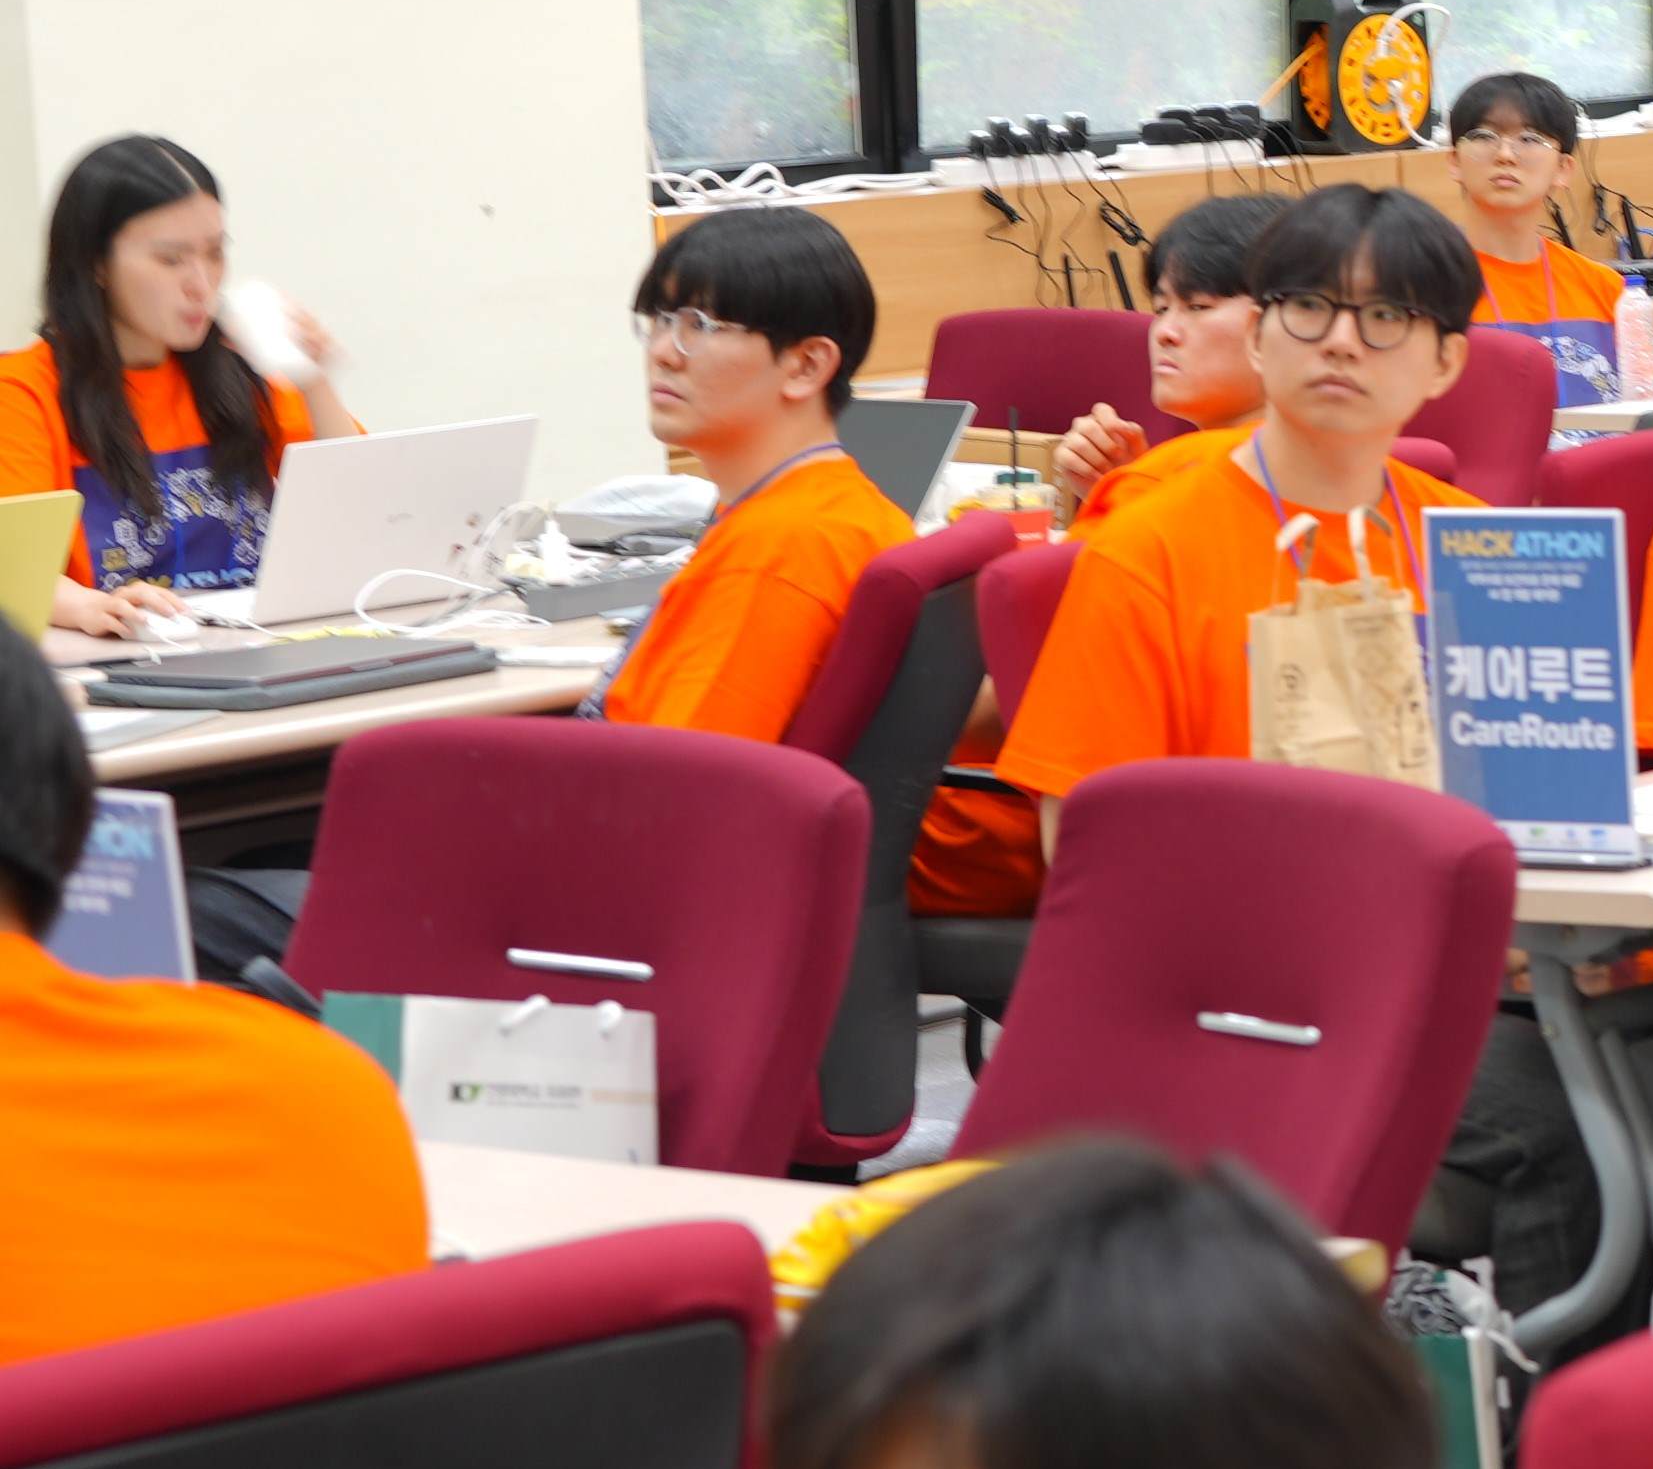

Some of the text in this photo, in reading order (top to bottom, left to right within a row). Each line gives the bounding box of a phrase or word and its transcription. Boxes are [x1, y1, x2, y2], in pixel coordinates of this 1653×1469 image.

[1440, 529, 1605, 558] HACKATHON
[1444, 645, 1615, 703] 케어루트
[1450, 711, 1616, 751] CareRoute
